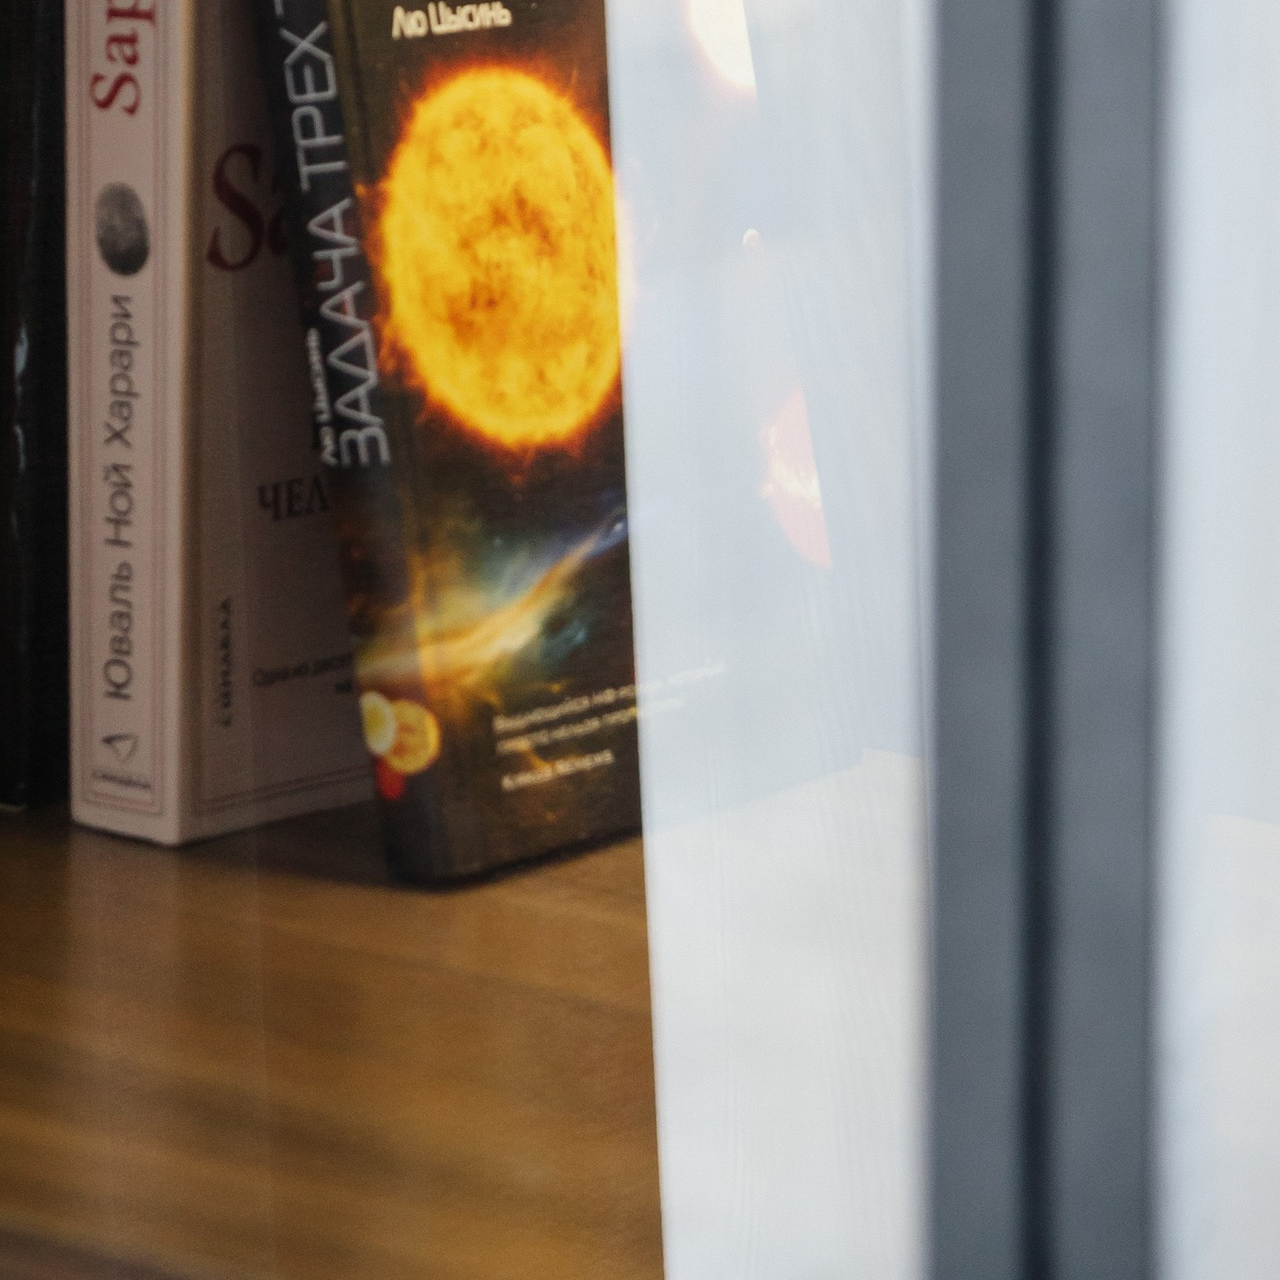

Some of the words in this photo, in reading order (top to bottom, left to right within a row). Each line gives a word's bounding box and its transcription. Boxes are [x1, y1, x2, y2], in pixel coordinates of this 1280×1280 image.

[278, 21, 347, 193] ТРЕХ
[103, 294, 141, 450] Харари
[307, 196, 392, 467] ЗАДАЧА
[103, 461, 135, 550] Ной
[103, 560, 135, 702] Юваль
